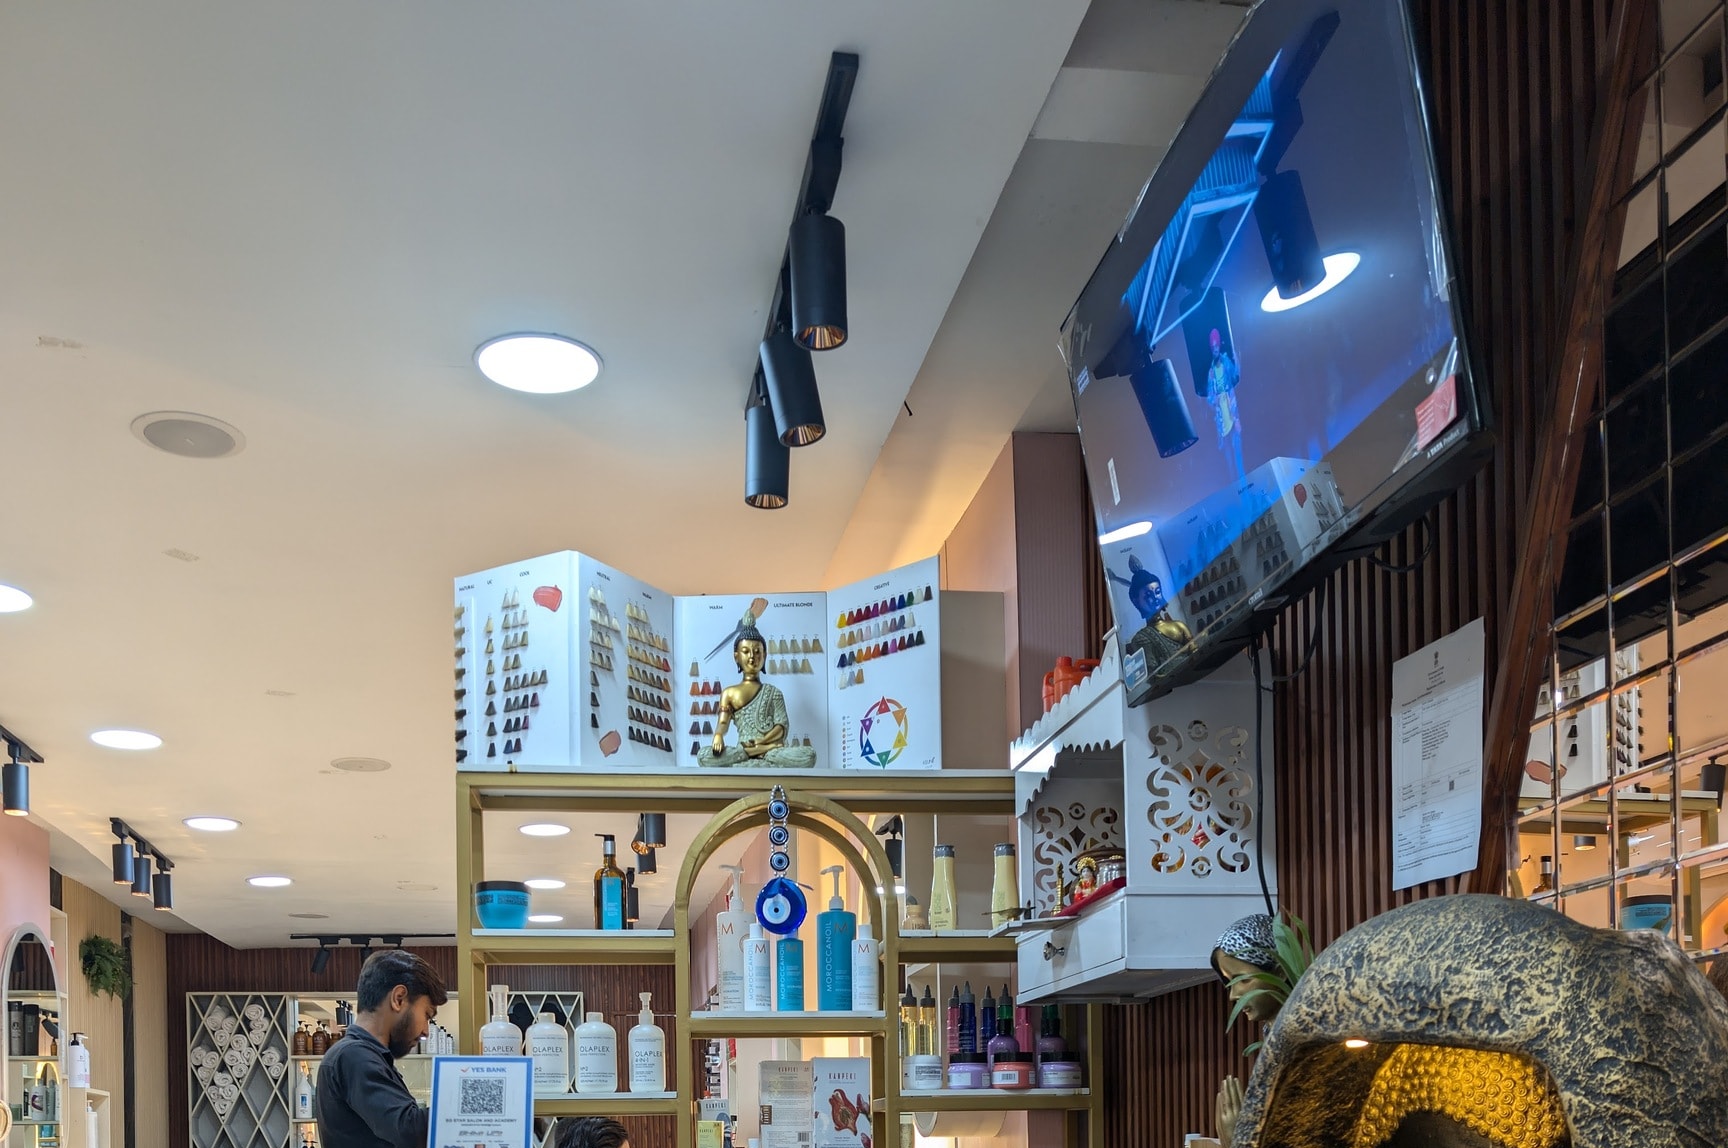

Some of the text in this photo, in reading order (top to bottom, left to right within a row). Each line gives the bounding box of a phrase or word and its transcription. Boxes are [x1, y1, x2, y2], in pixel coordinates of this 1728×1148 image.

[721, 922, 734, 935] M
[834, 922, 848, 935] M
[754, 943, 767, 954] M
[786, 943, 798, 953] M
[858, 943, 870, 954] M
[824, 921, 833, 992] MOROCCANOIL
[484, 1045, 514, 1053] OLAPLEX
[579, 1045, 610, 1053] OLAPLEX
